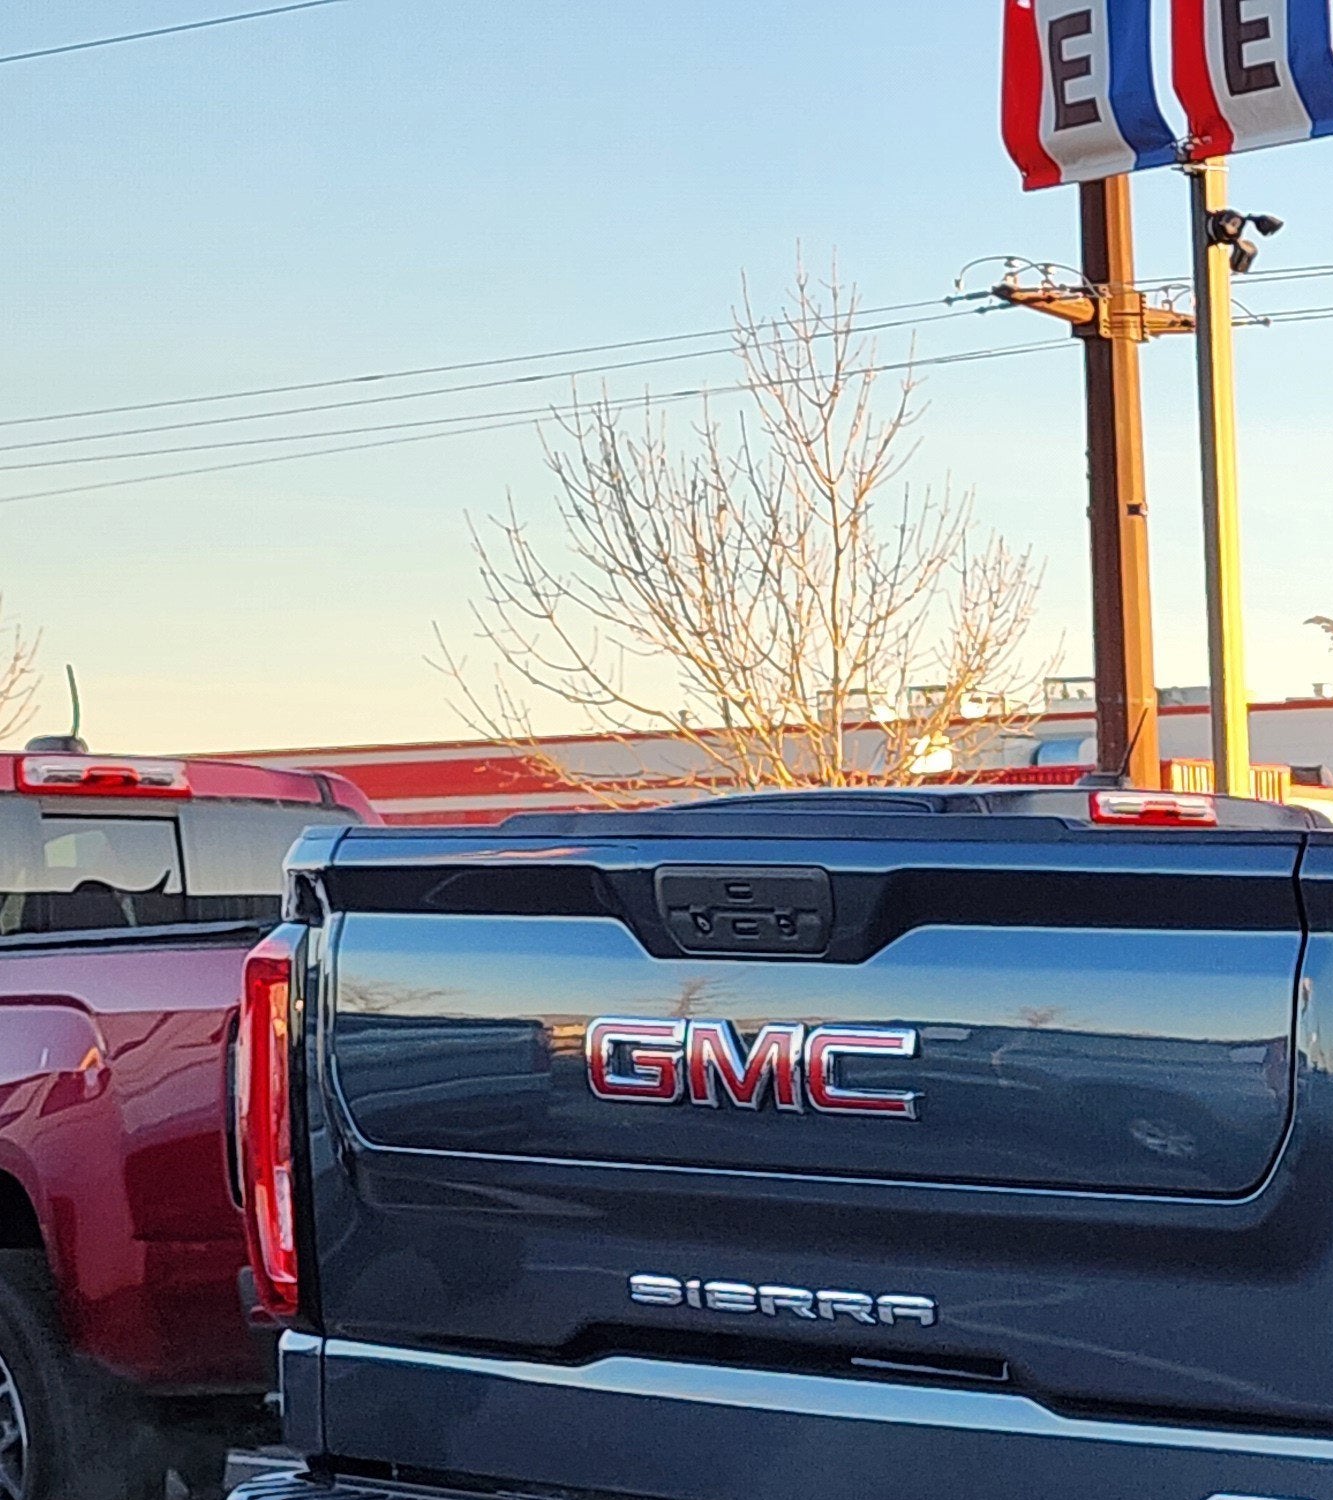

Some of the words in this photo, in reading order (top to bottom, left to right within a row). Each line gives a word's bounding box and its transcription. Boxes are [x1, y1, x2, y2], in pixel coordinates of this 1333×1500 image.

[1048, 8, 1102, 131] E
[586, 1016, 925, 1120] GMC
[630, 1274, 937, 1327] SIERRA
